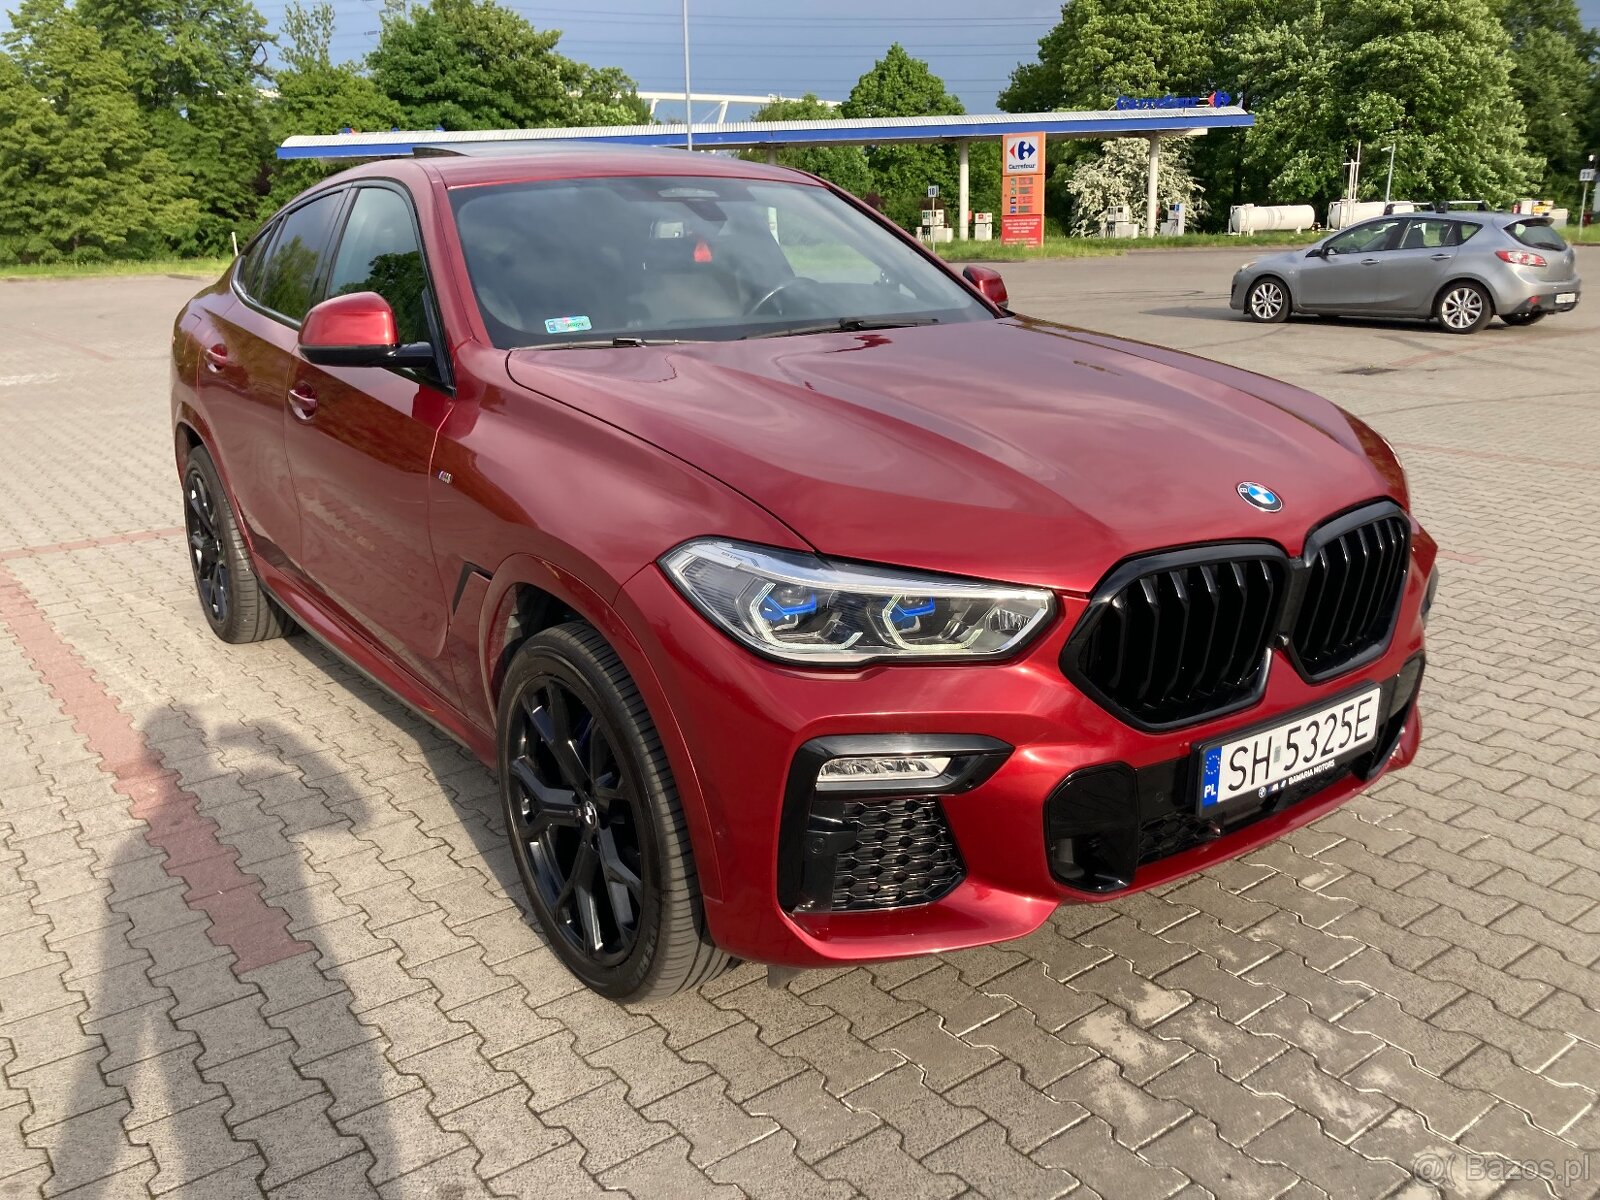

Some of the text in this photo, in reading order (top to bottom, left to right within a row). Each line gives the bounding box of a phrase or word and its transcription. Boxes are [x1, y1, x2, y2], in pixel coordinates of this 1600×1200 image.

[1228, 697, 1373, 791] SH 5325E
[1313, 759, 1335, 775] MOTORS
[1204, 784, 1217, 799] PL
